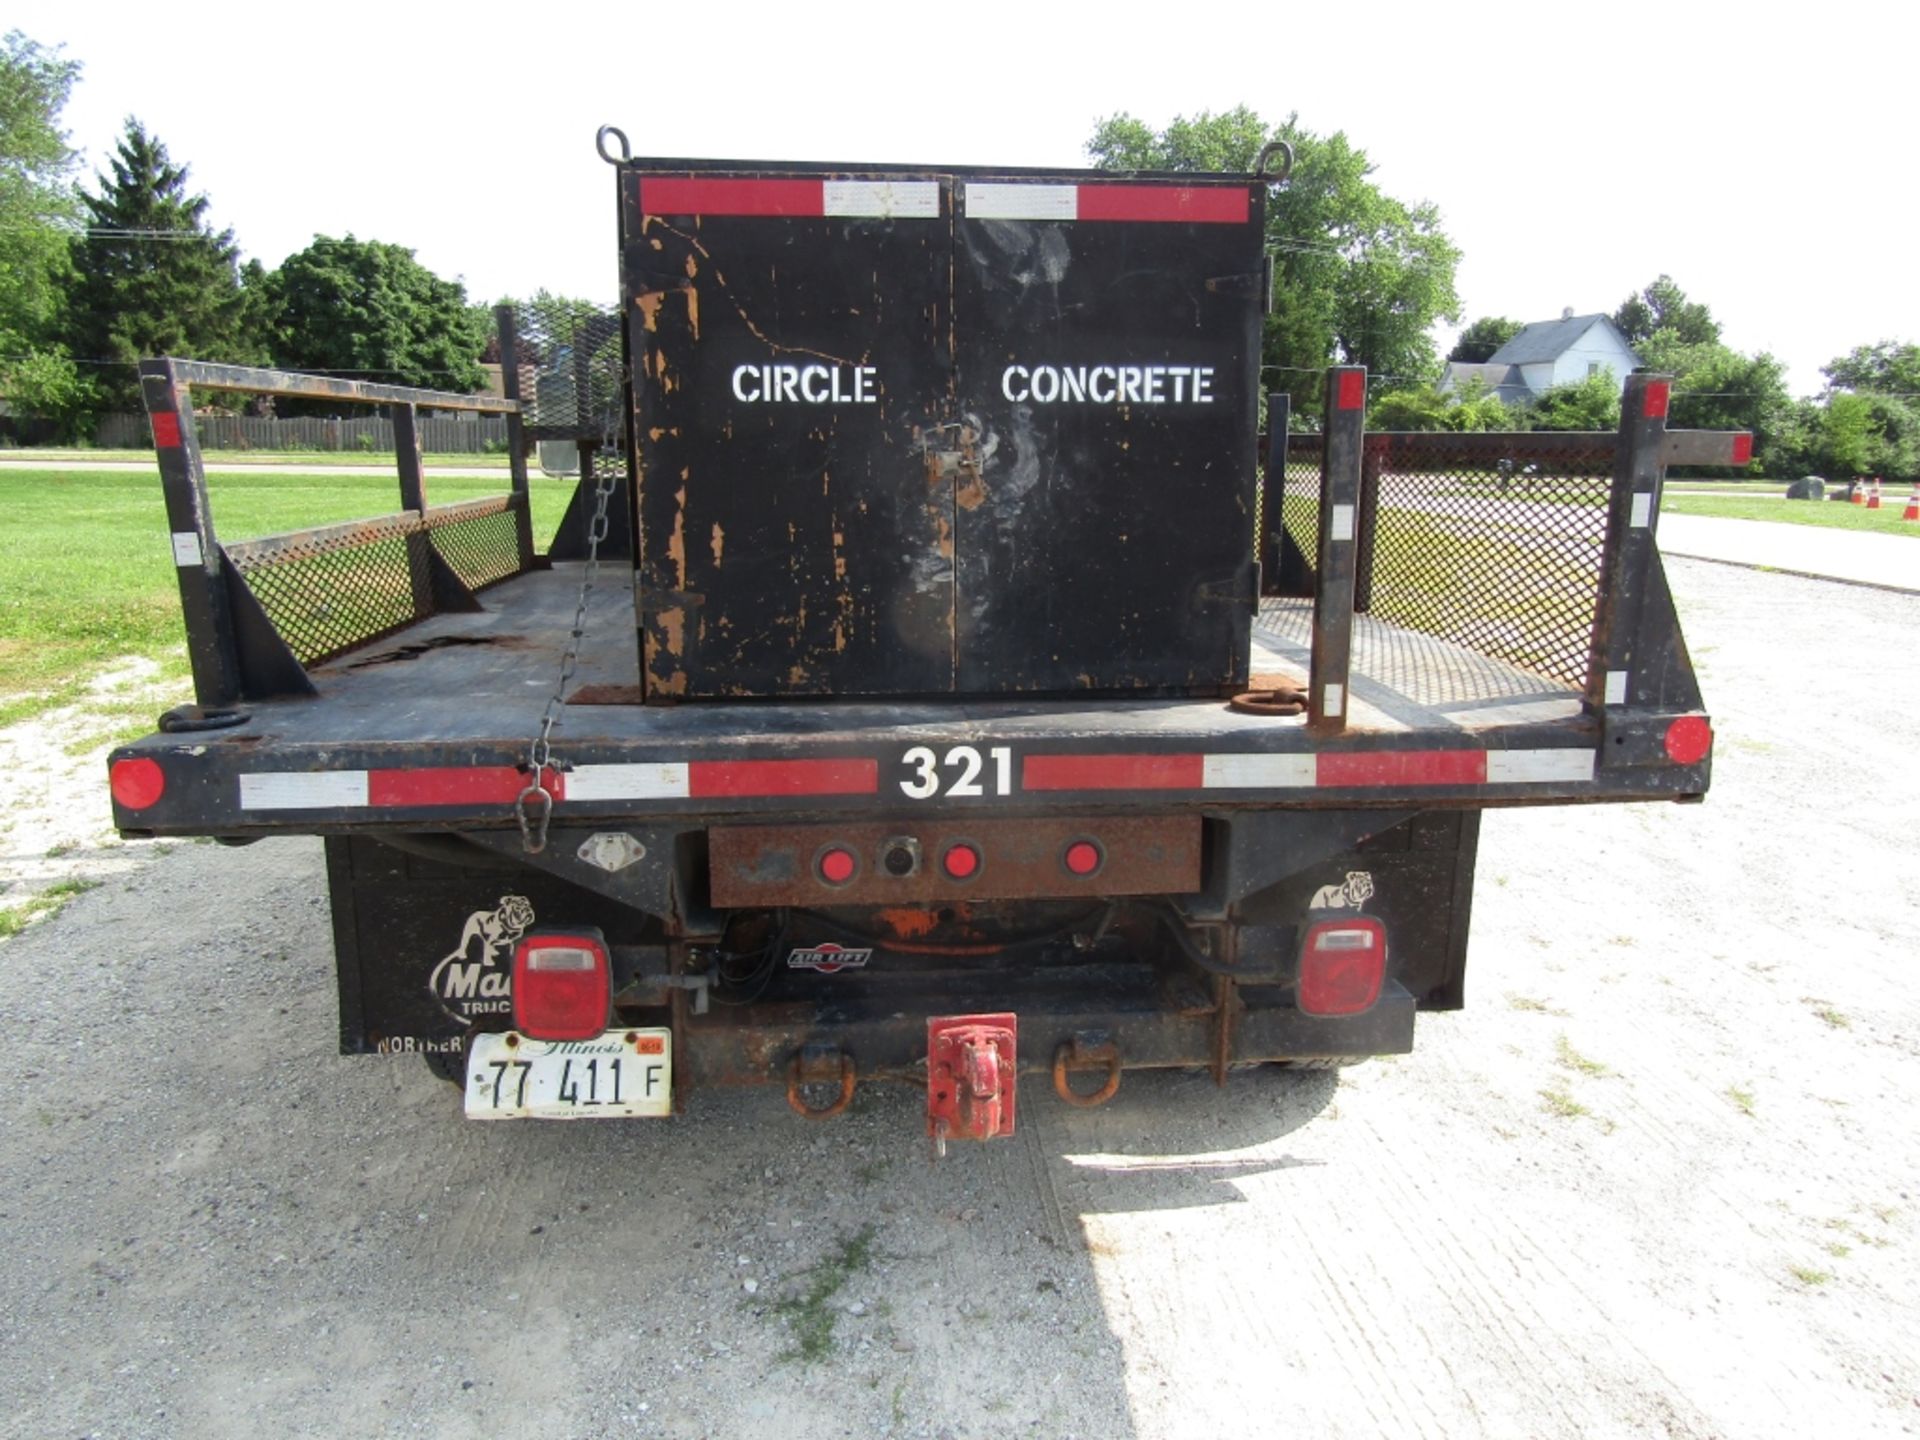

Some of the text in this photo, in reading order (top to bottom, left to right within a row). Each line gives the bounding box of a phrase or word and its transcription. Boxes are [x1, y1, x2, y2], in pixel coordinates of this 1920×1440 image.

[731, 364, 1215, 404] CIRCLE CONCRETE
[899, 745, 1012, 799] 321
[791, 953, 864, 963] AIR LIFT
[443, 963, 511, 998] Ma
[461, 1001, 511, 1015] TRUC
[377, 1035, 466, 1054] NORTHER
[543, 1040, 624, 1056] Illinois
[488, 1058, 663, 1108] 77 411 F
